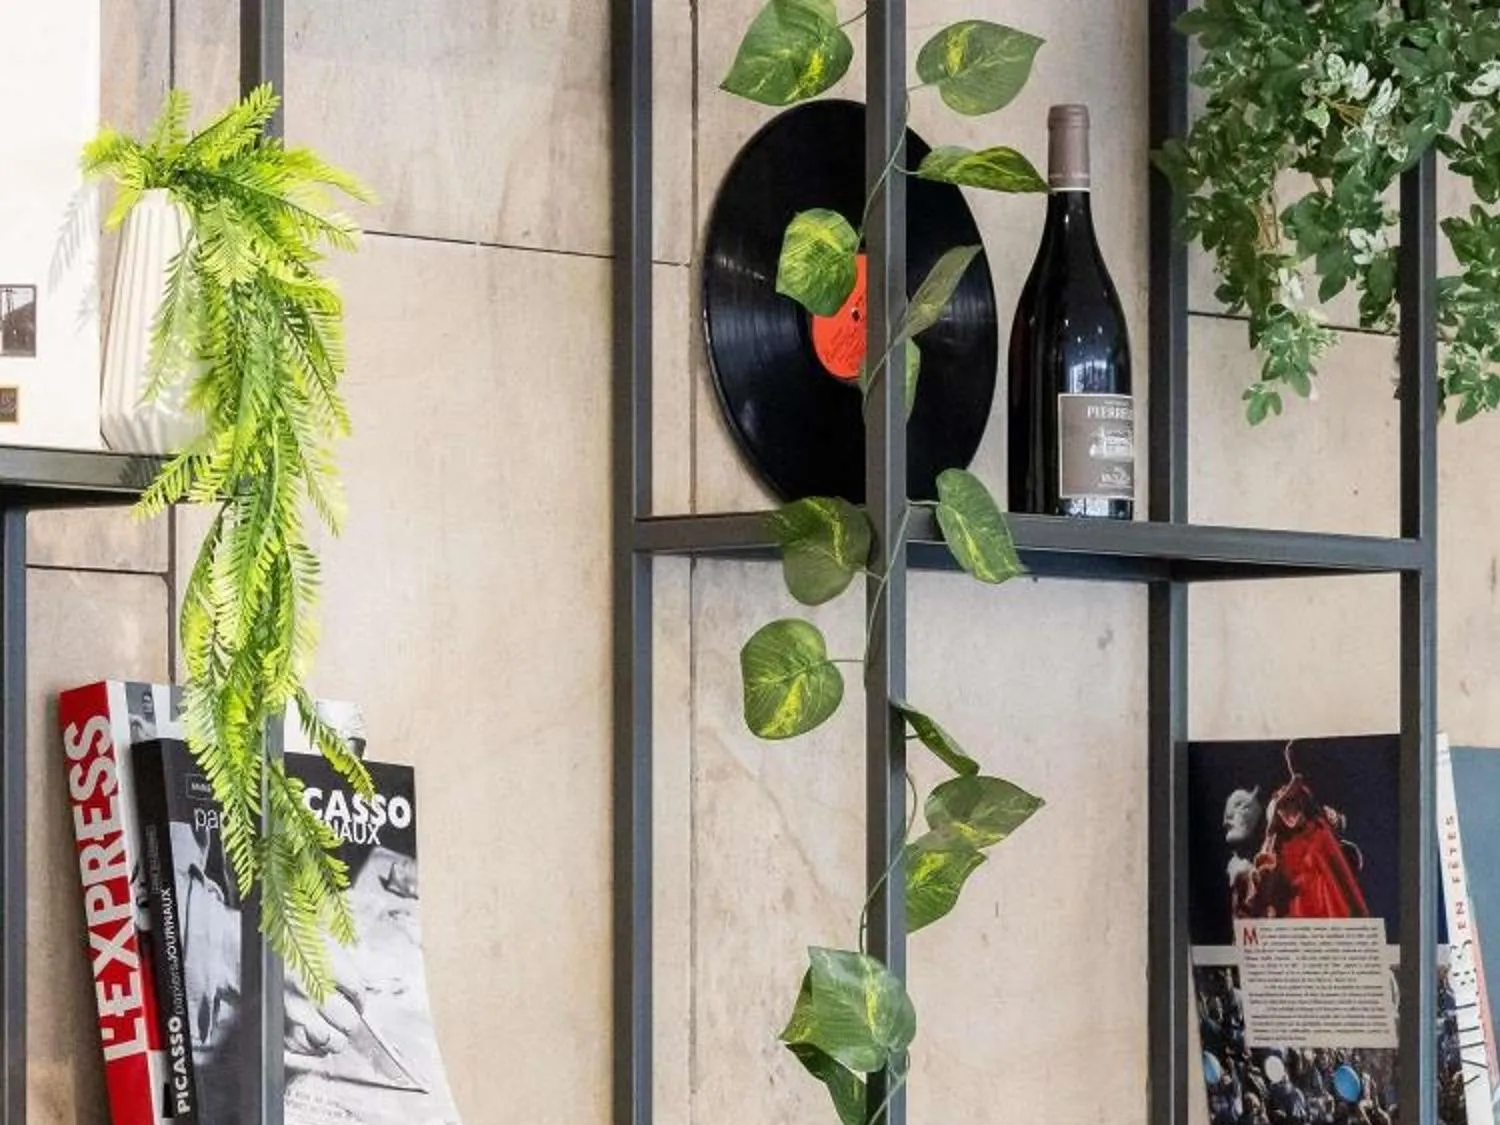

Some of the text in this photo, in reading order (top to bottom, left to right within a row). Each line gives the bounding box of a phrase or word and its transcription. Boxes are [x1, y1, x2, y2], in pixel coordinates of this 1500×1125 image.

[302, 787, 412, 829] CASSO
[63, 715, 146, 1061] L'EXPRESS
[167, 1016, 192, 1115] PICASSO
